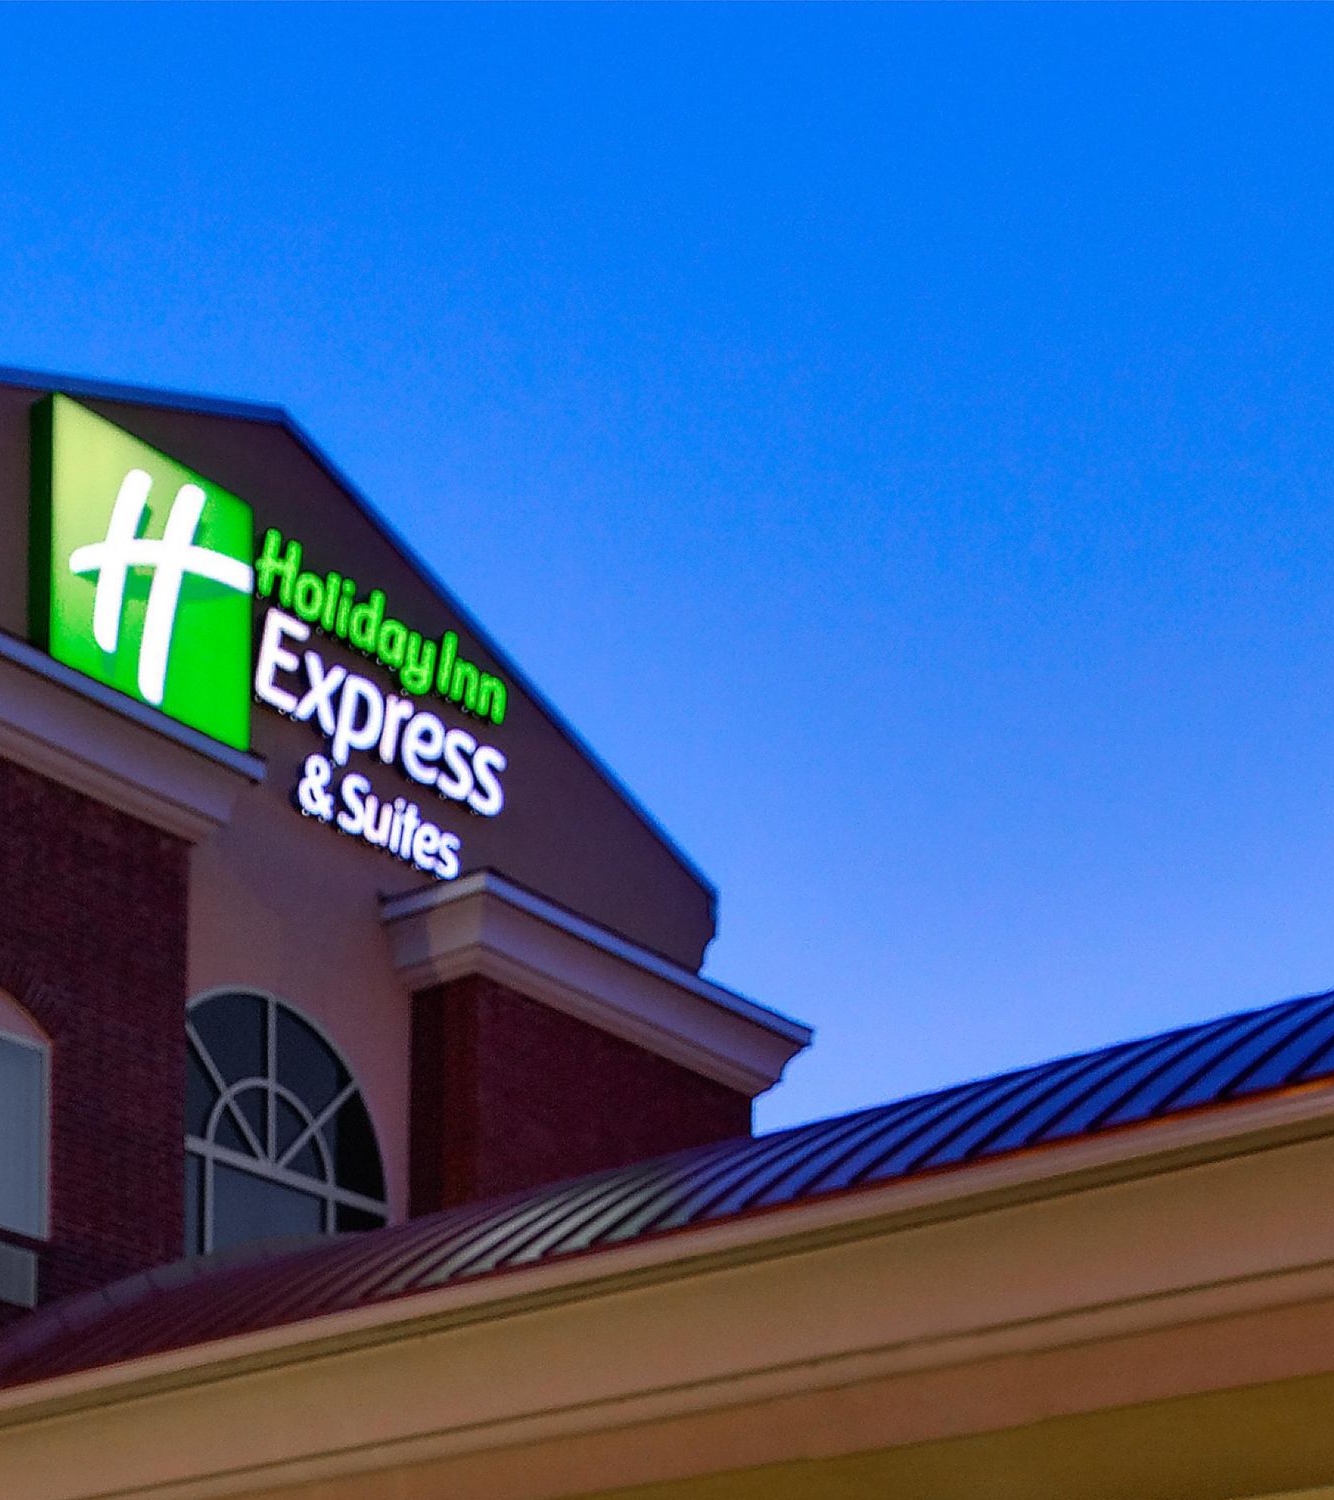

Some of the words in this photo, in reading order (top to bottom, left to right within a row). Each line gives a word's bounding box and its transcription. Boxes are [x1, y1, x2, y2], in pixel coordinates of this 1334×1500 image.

[255, 528, 436, 696] Holiday
[436, 630, 507, 725] Inn
[255, 607, 507, 817] Express
[298, 753, 333, 820] &
[337, 773, 460, 881] Suites
